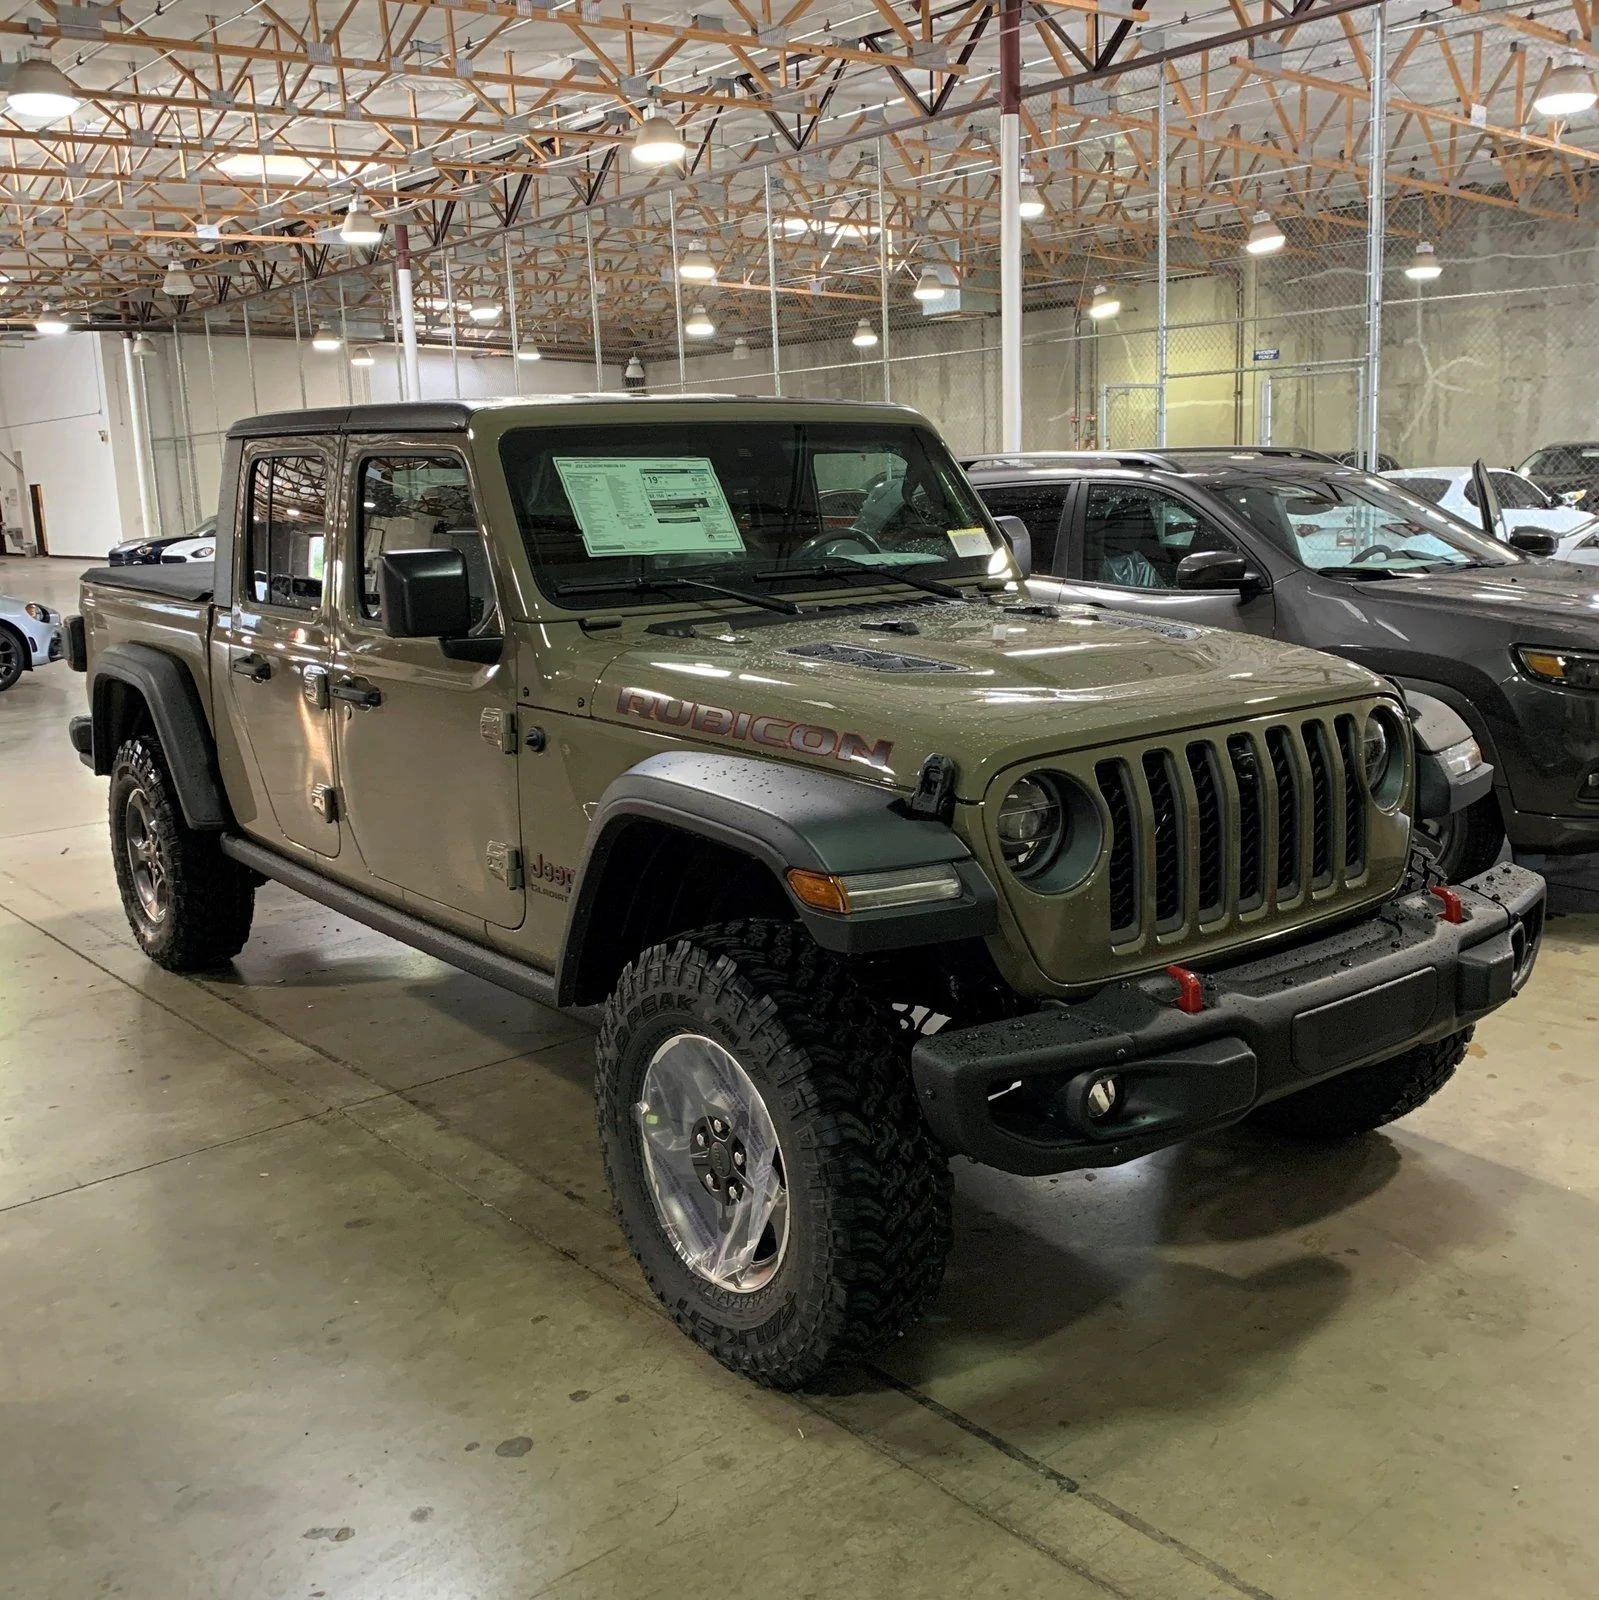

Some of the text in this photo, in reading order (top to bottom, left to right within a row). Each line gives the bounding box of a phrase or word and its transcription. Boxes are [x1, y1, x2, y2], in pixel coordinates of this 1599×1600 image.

[647, 476, 659, 485] 19
[616, 686, 895, 768] RUBICON
[530, 852, 576, 894] Jeep
